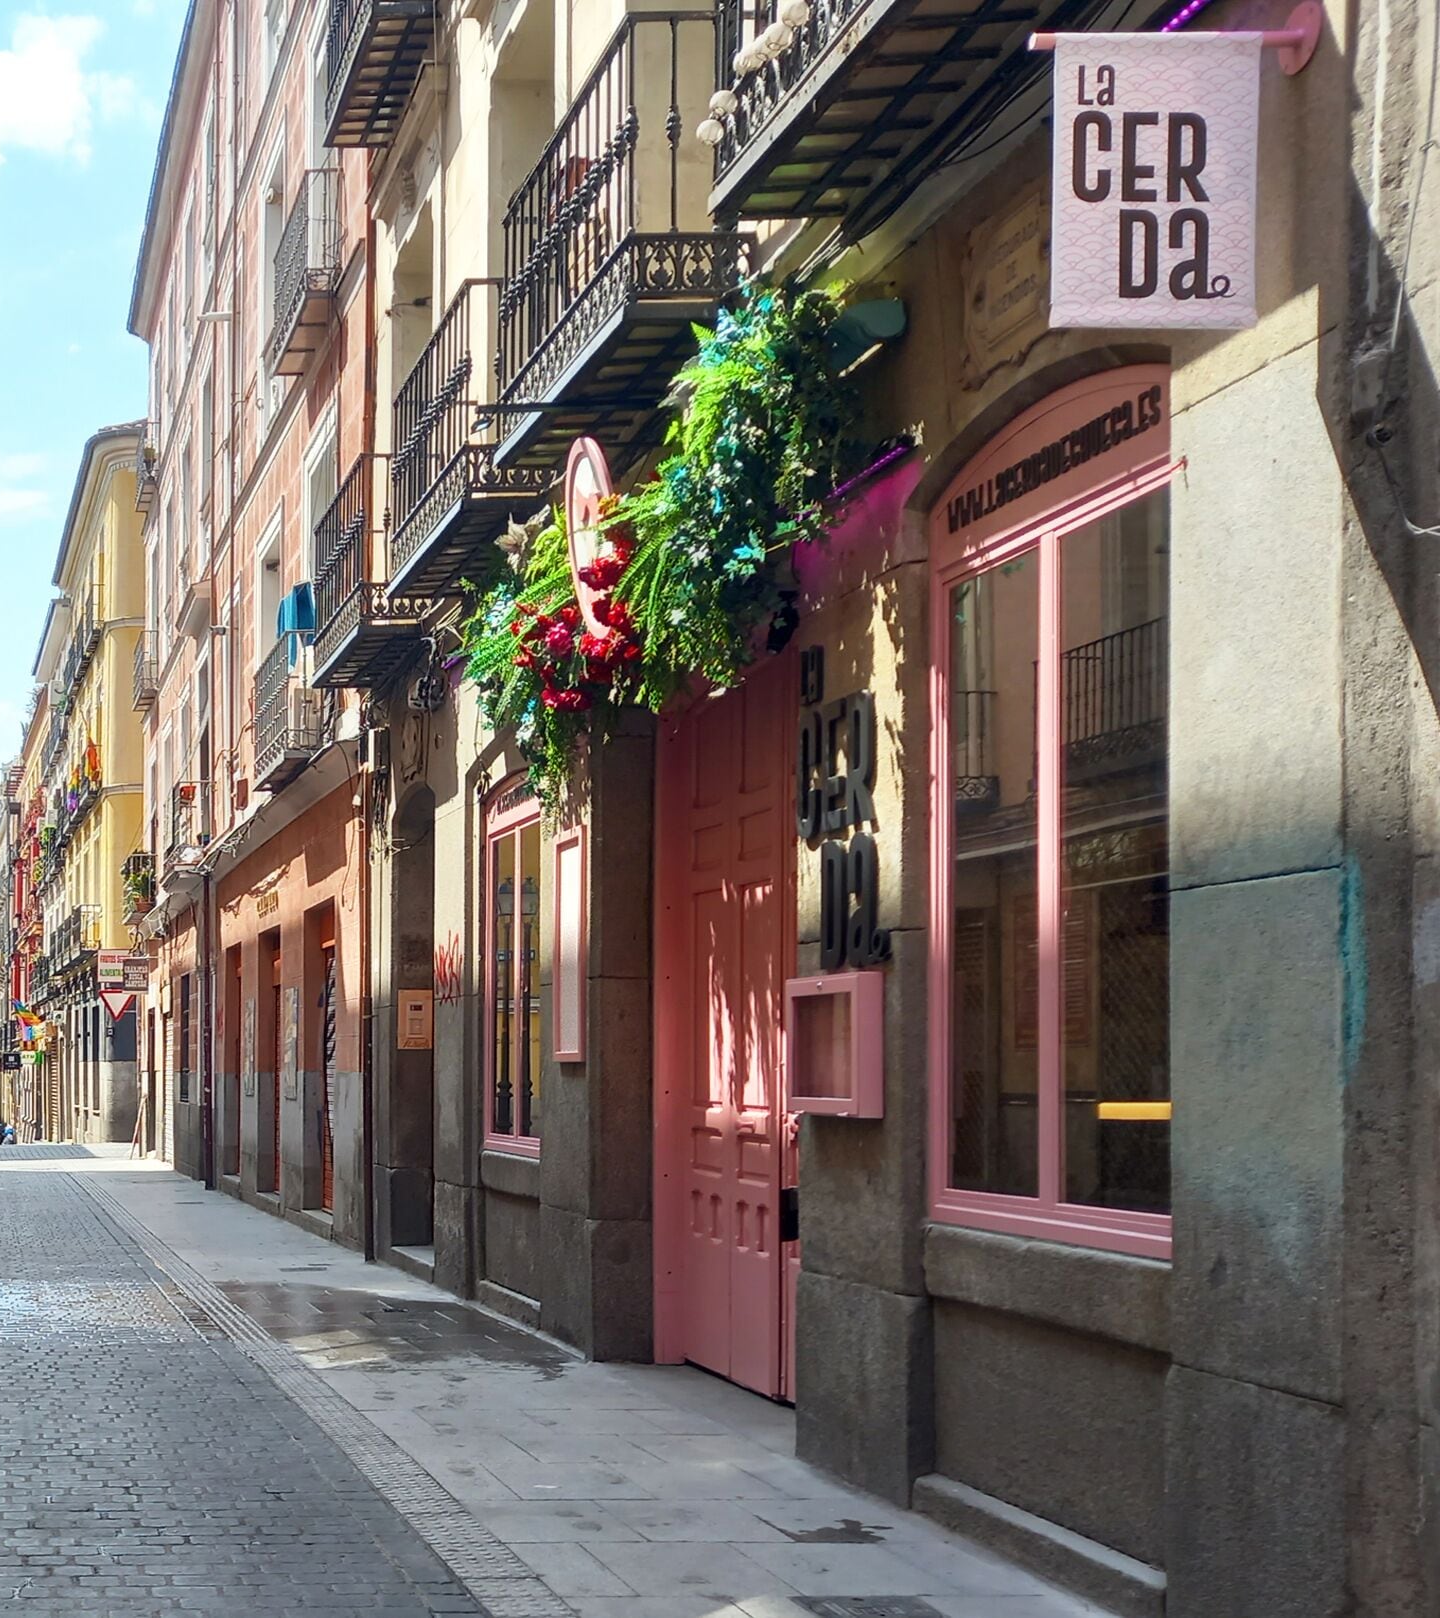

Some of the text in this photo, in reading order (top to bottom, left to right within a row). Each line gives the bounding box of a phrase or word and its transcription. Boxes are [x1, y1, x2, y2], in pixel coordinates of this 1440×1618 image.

[1077, 64, 1115, 106] La
[1072, 110, 1210, 203] CER
[1119, 208, 1236, 300] Da
